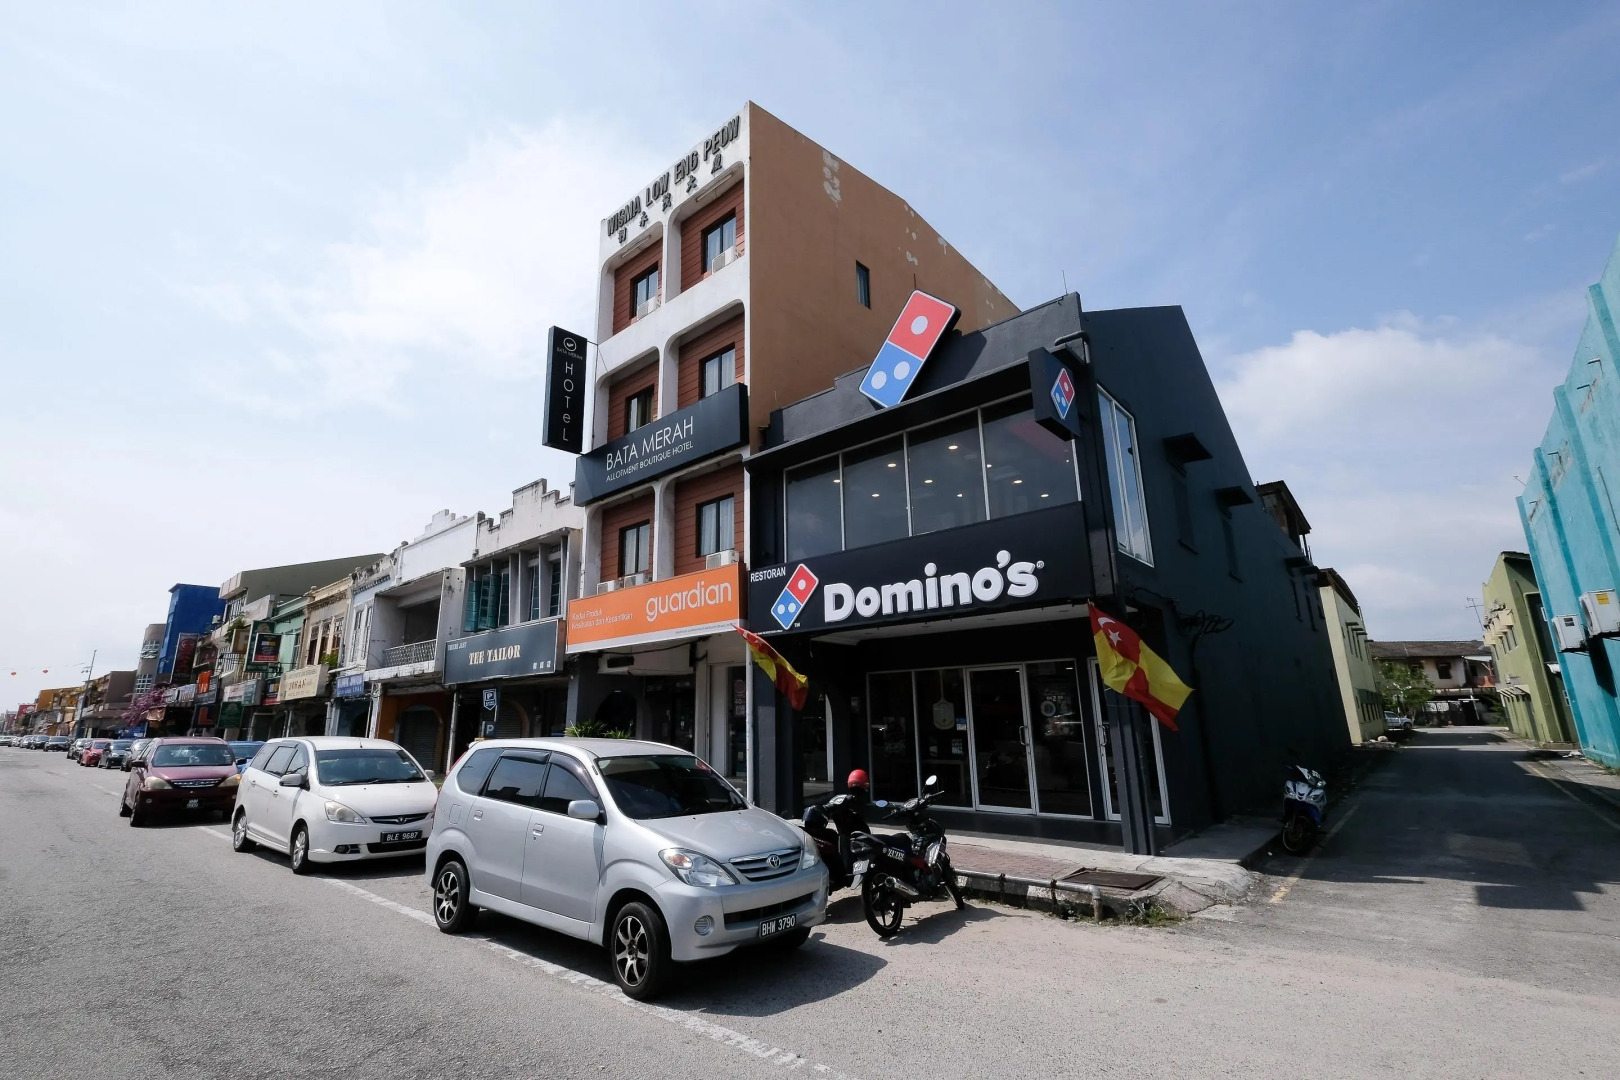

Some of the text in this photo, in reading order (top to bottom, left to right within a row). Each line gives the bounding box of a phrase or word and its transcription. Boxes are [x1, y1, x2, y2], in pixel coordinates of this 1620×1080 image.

[607, 115, 740, 237] WISMA LOW ENG PEOW
[556, 346, 583, 361] BATA MERAH
[606, 415, 694, 471] BATA MERAH
[605, 440, 694, 483] ALLOTMENT BOUTIQUE HOTEL
[750, 566, 786, 583] RESTORAN
[823, 550, 1040, 623] Domino's
[645, 580, 732, 622] guardian
[468, 651, 485, 665] TEE
[487, 644, 521, 663] TAILOR
[486, 724, 494, 734] P
[386, 831, 418, 842] BLE 9687
[761, 915, 796, 937] BHW 3790
